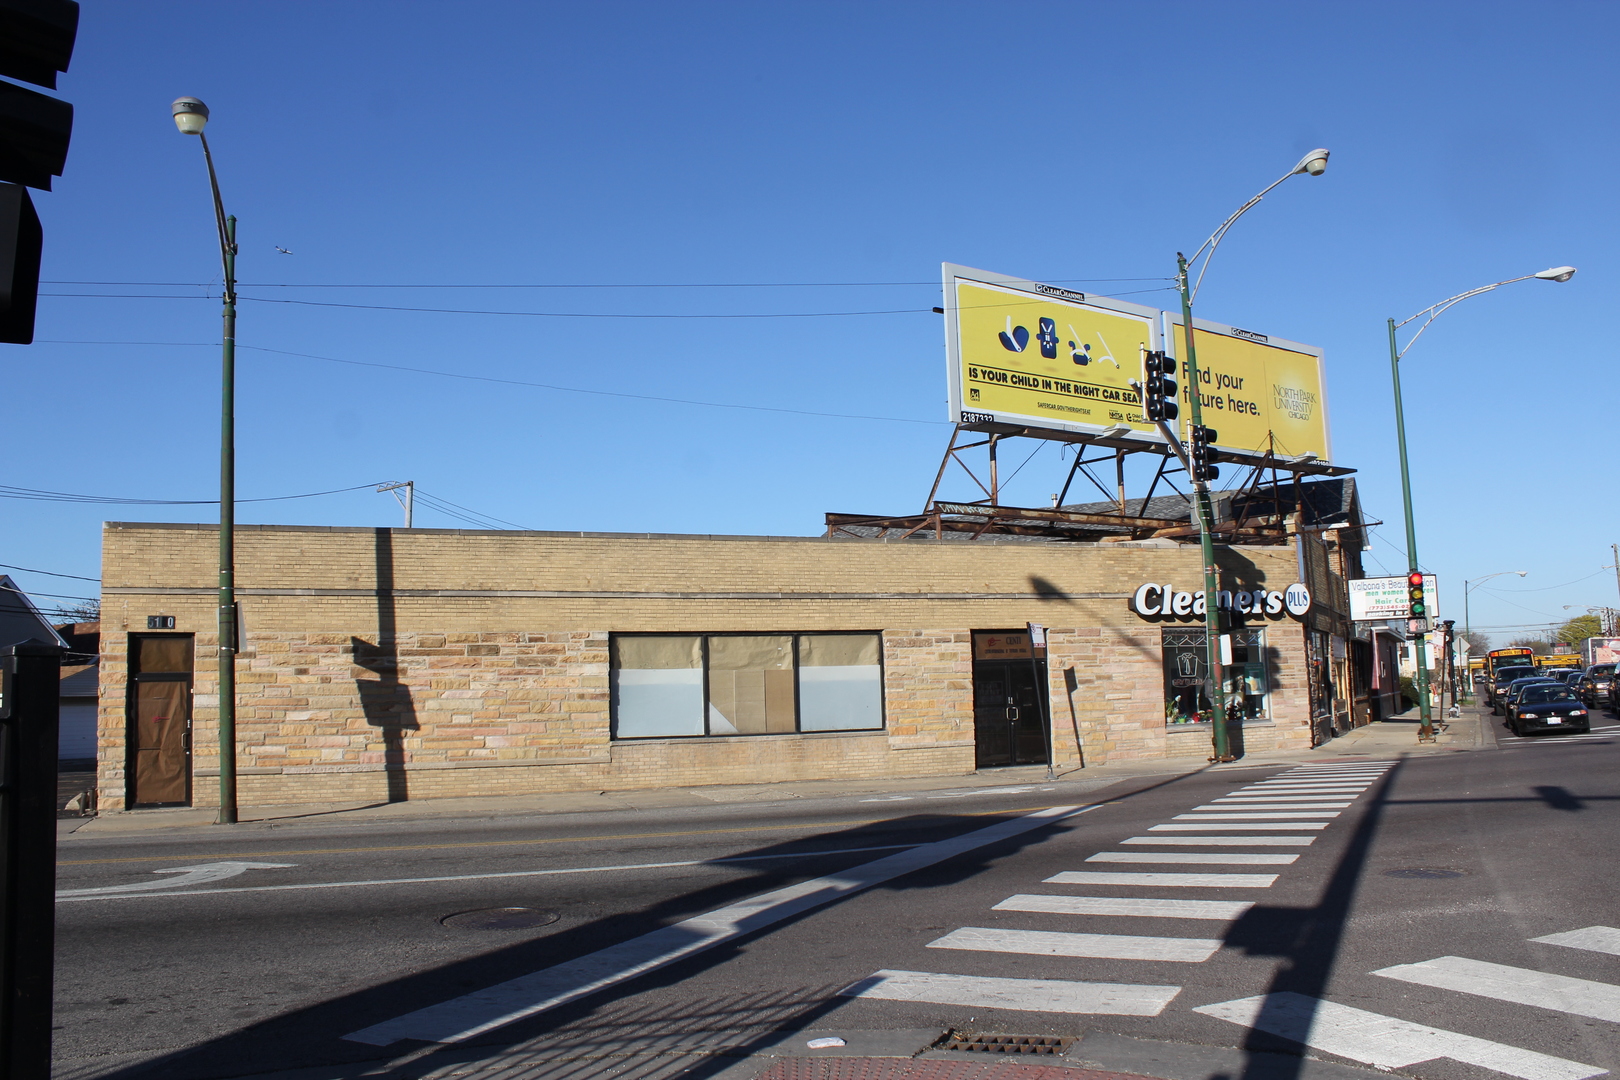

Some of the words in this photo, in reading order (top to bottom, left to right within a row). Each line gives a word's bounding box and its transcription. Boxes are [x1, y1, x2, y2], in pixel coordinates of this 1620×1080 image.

[969, 367, 979, 379] IS
[981, 369, 1008, 383] YOUR
[1010, 374, 1040, 388] CHILD
[1042, 379, 1052, 390] IN
[1054, 381, 1072, 394] THE
[1074, 384, 1100, 398] RIGHT
[1102, 389, 1121, 401] CAR
[1215, 372, 1244, 391] your
[1228, 394, 1261, 416] here.
[1274, 397, 1313, 415] UNIVERSITY
[1288, 411, 1310, 421] CHICAGO
[1388, 579, 1408, 589] Beaut
[1135, 583, 1284, 615] Cleaners
[1288, 591, 1309, 607] PLUS
